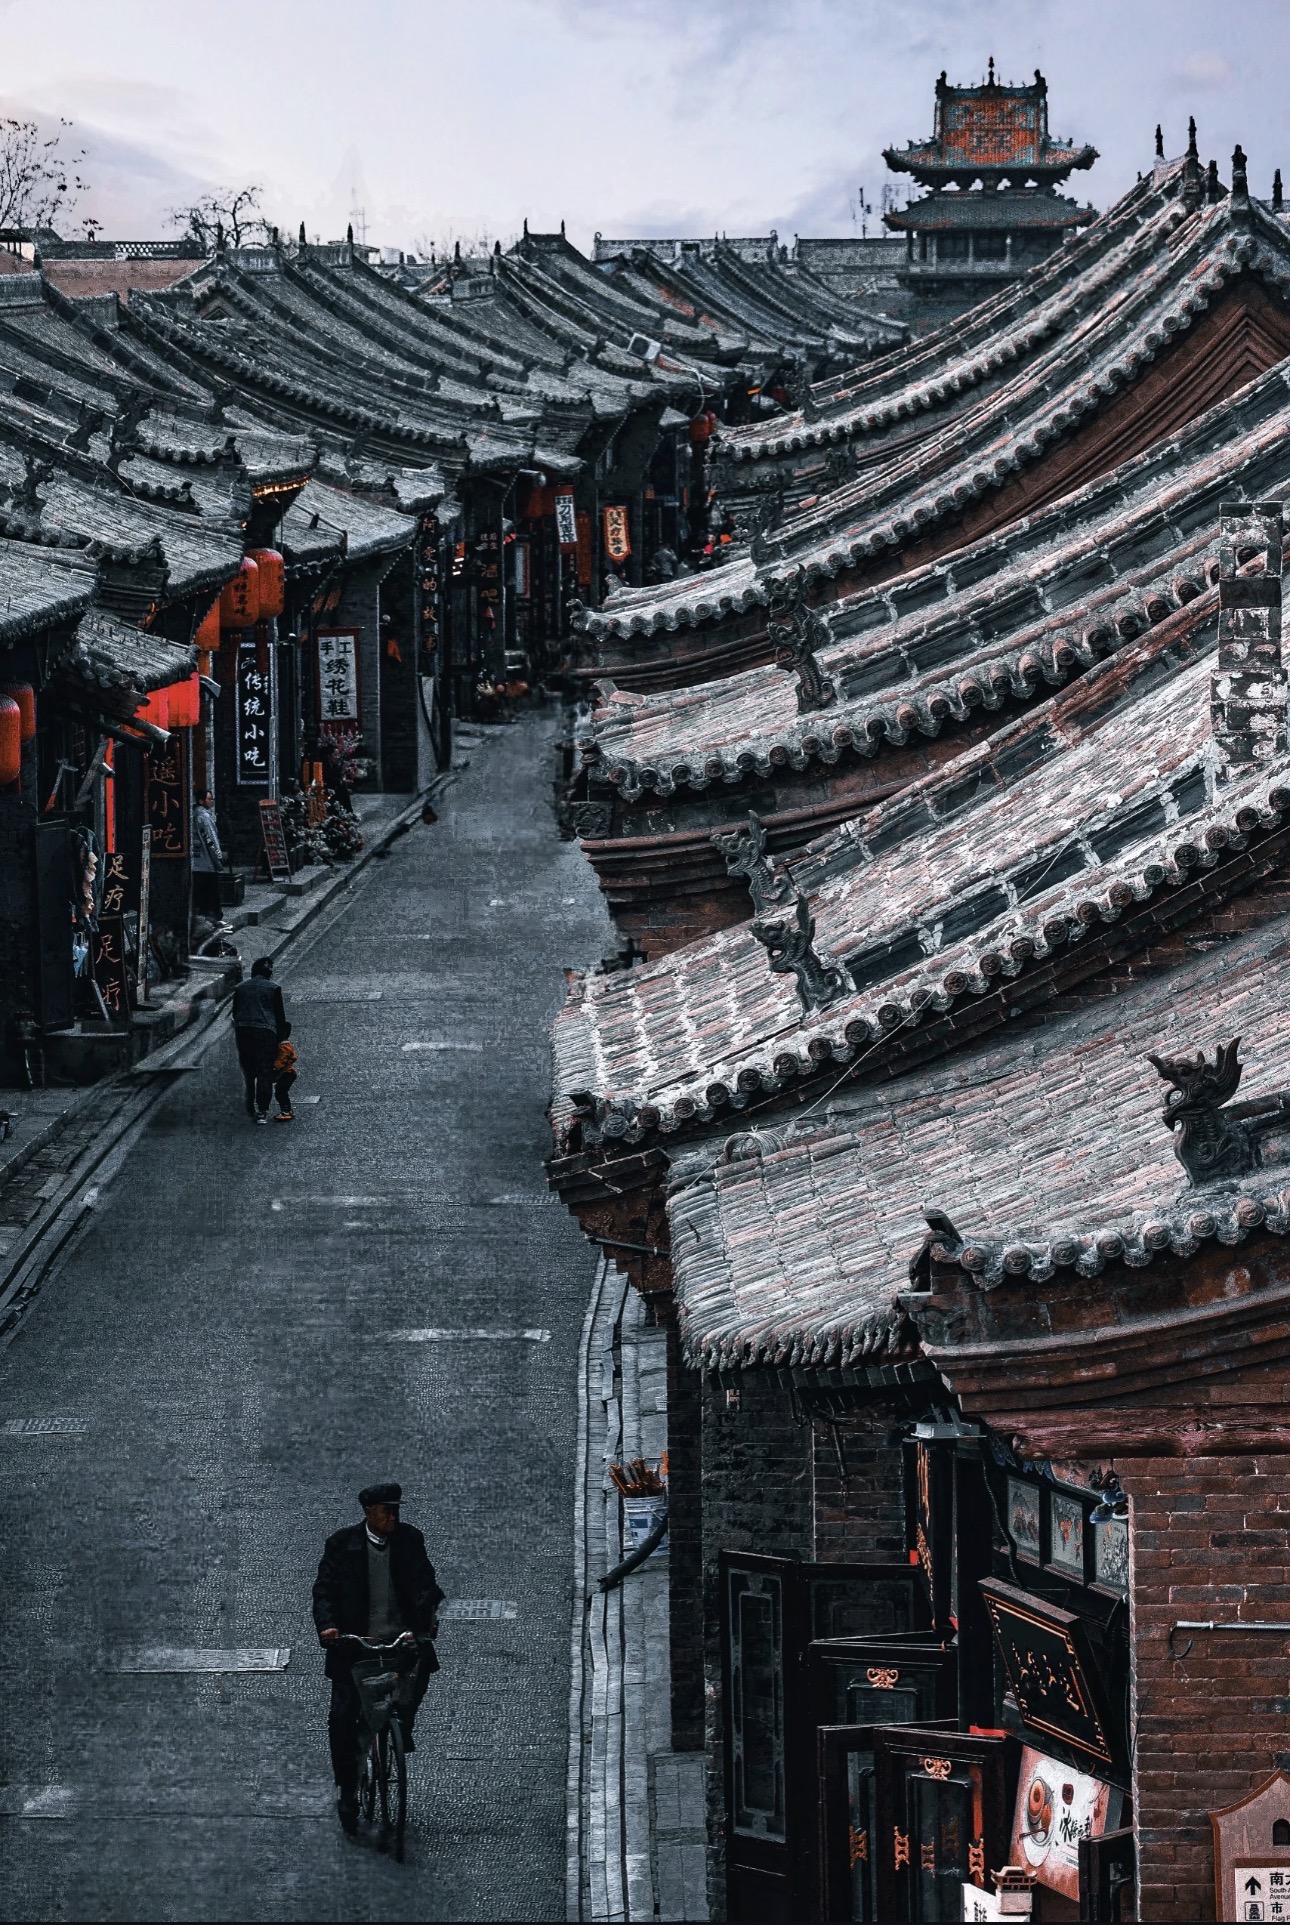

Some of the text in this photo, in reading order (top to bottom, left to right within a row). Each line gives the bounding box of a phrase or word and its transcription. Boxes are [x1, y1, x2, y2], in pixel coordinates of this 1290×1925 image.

[320, 641, 353, 656] 手工
[324, 657, 351, 717] 绣花鞋
[243, 668, 266, 768] 传统小吃
[150, 740, 183, 850] 遥小吃
[104, 853, 131, 912] 足疗
[95, 932, 123, 1012] 足疗
[1270, 1901, 1284, 1914] 市
